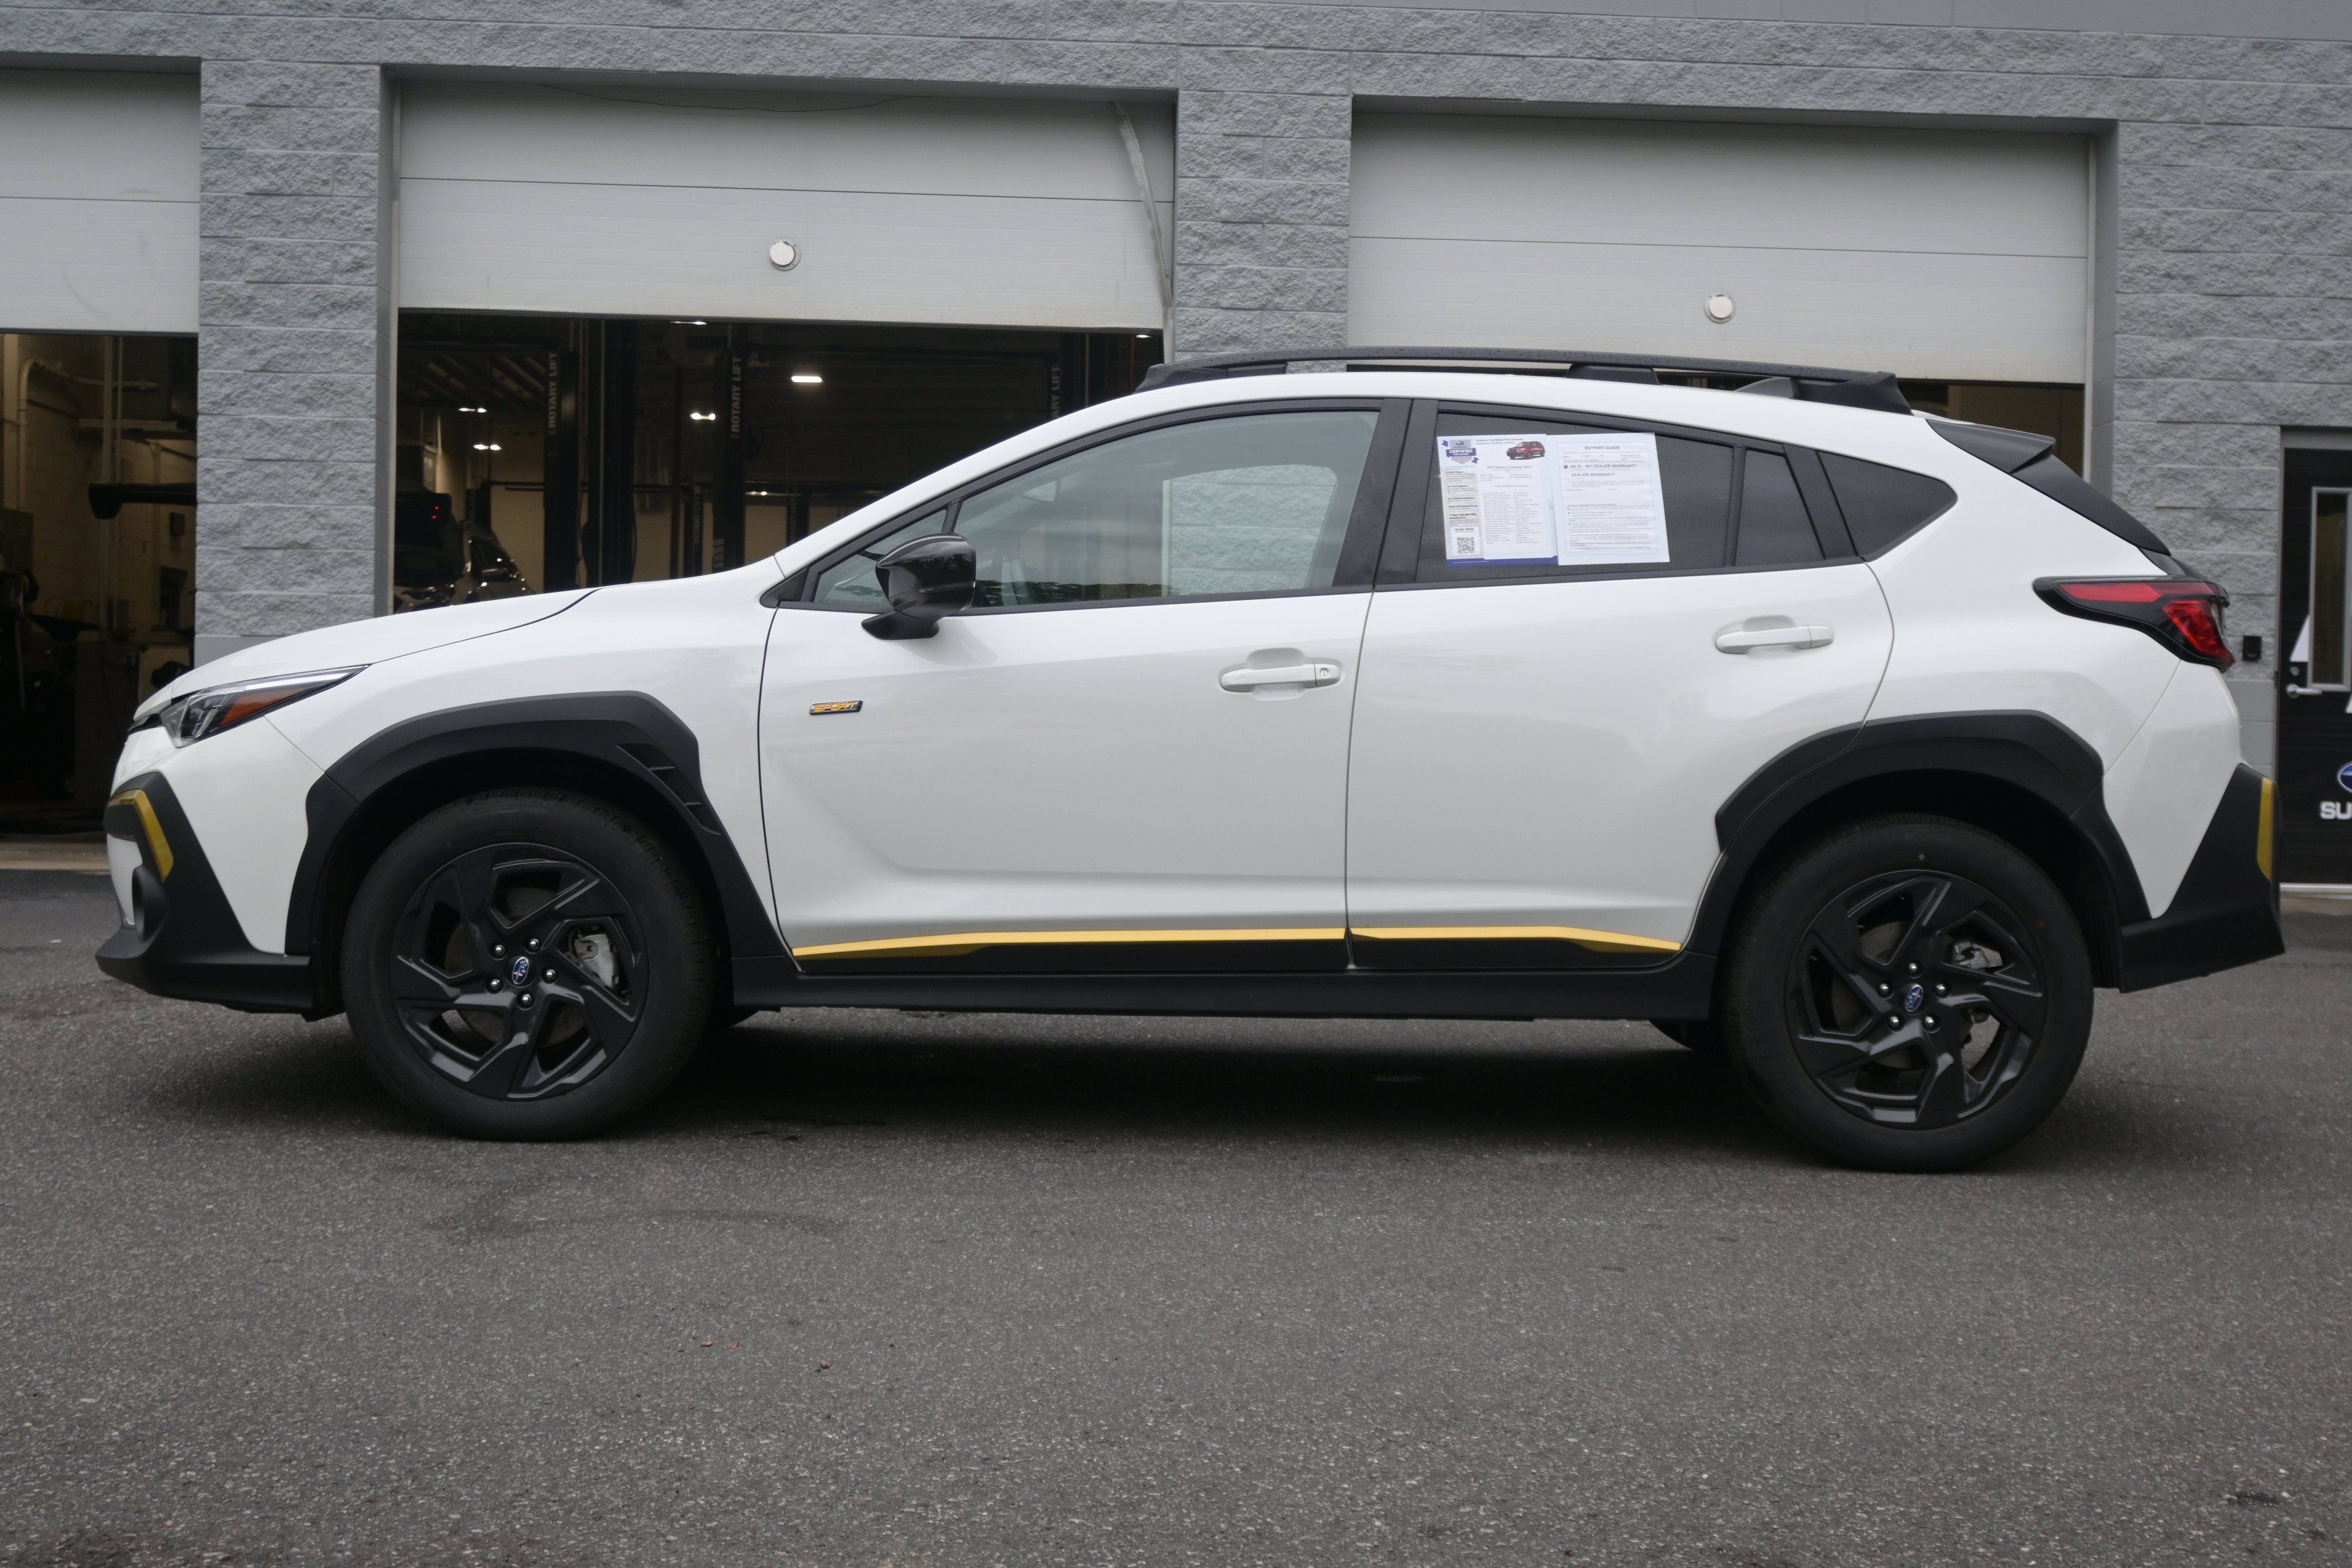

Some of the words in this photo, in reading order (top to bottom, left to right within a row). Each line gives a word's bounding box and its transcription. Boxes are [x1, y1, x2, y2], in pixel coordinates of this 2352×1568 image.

[549, 352, 557, 377] LIFT
[732, 355, 741, 381] LIFT
[1051, 366, 1060, 390] LIFT
[548, 380, 557, 428] ROTARY
[731, 384, 740, 432] ROTARY
[814, 702, 858, 712] SPORT
